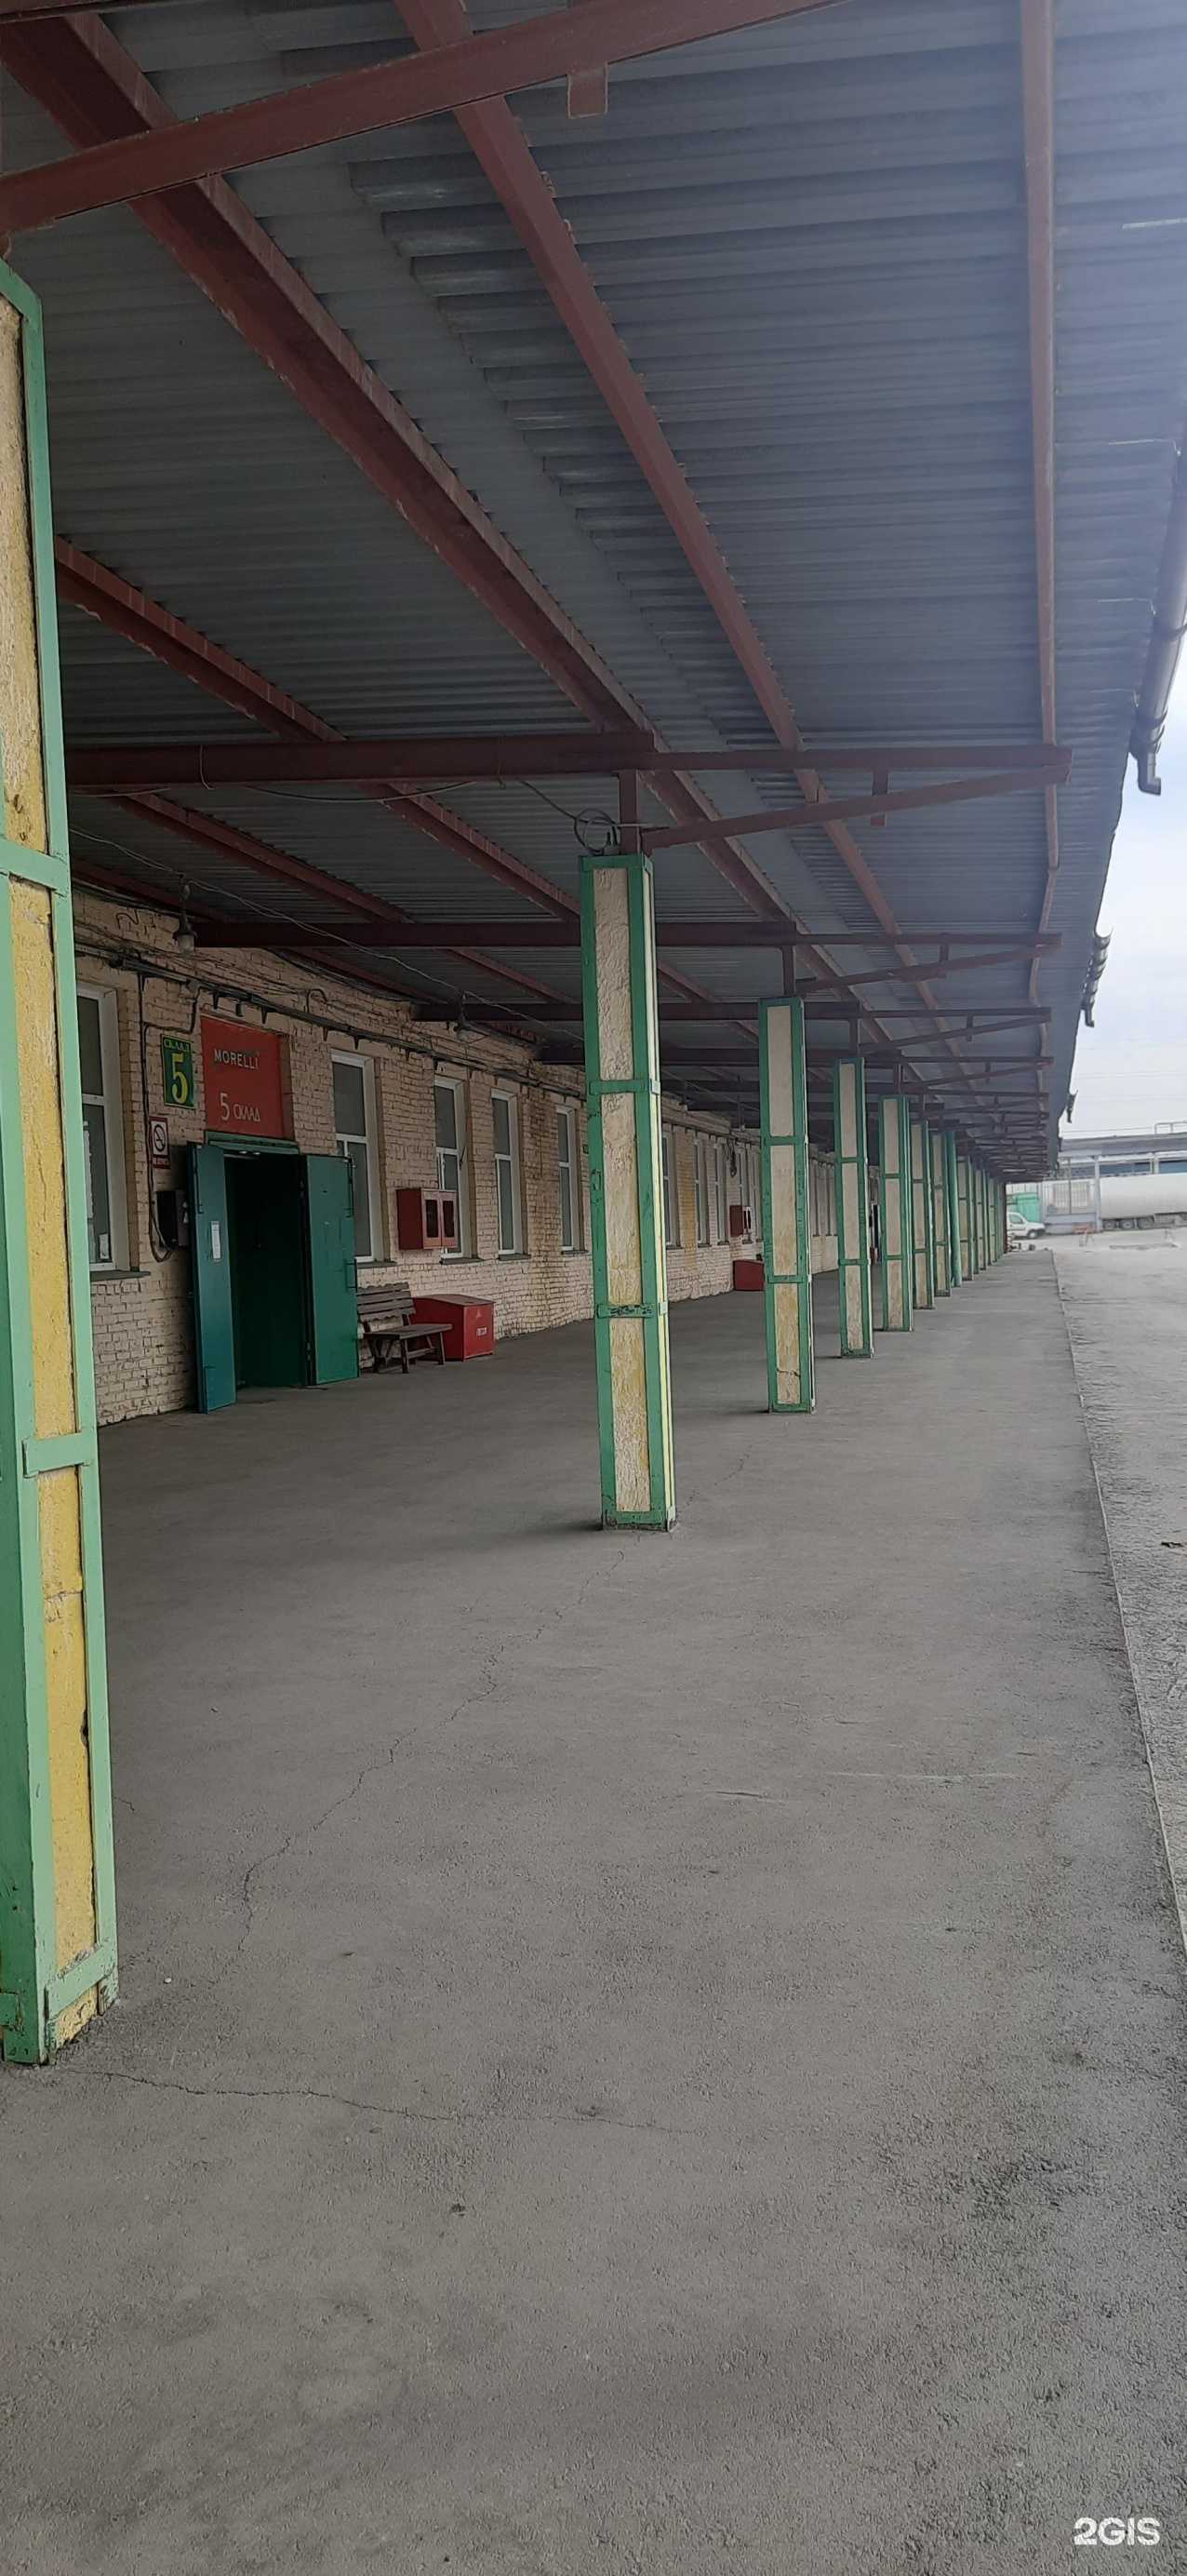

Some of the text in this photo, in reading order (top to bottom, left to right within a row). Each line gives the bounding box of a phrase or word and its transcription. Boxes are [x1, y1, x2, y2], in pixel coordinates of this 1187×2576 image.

[214, 1048, 259, 1069] MORELLI
[171, 1053, 188, 1104] 5
[220, 1093, 231, 1120] 5
